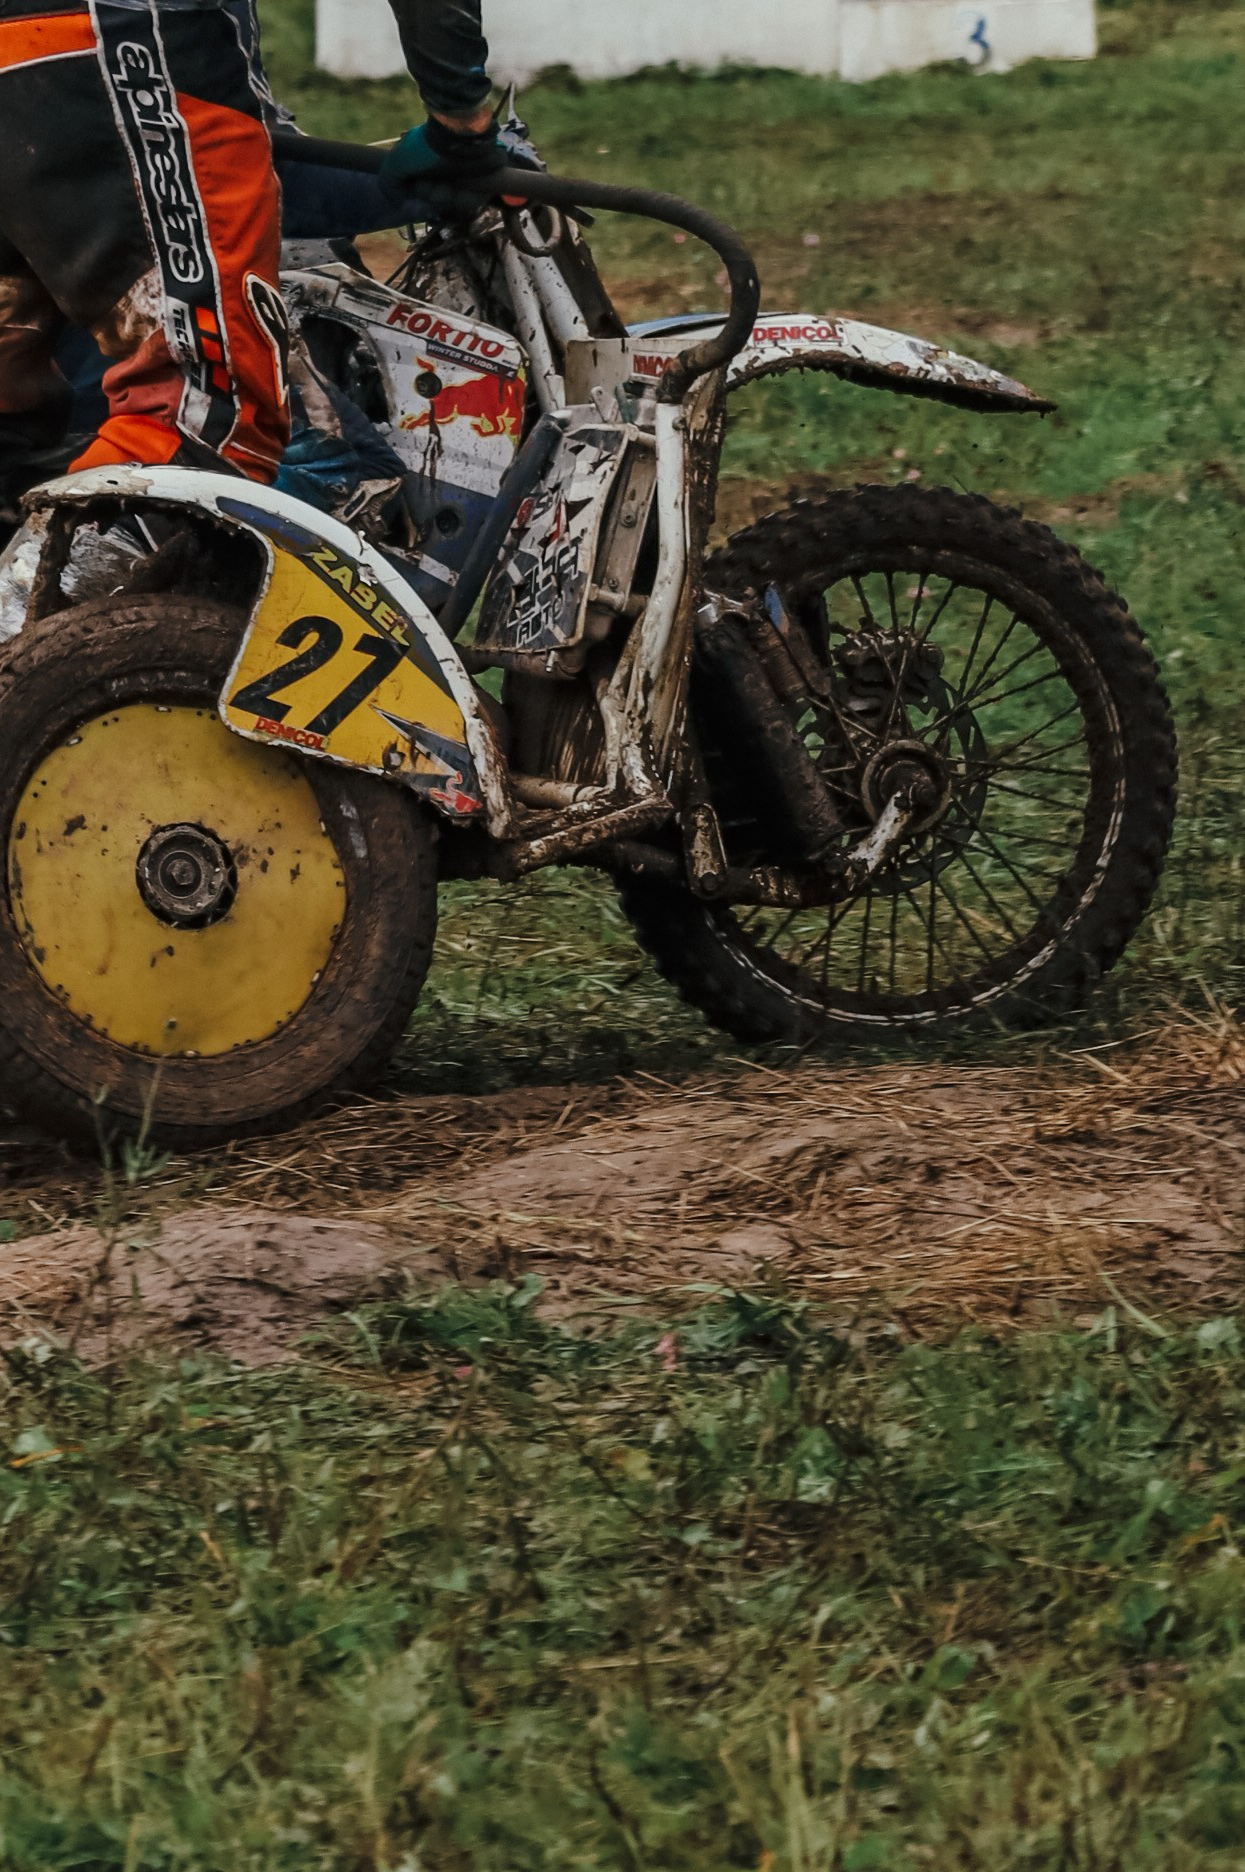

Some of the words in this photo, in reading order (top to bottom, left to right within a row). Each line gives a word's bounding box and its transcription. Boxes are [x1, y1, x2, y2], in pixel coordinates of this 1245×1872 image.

[957, 12, 993, 66] 3
[112, 42, 204, 283] alpinestars
[427, 343, 462, 361] WINTER
[754, 325, 842, 343] DENICOL
[311, 546, 410, 646] ZABEL
[255, 714, 328, 751] DENICOL
